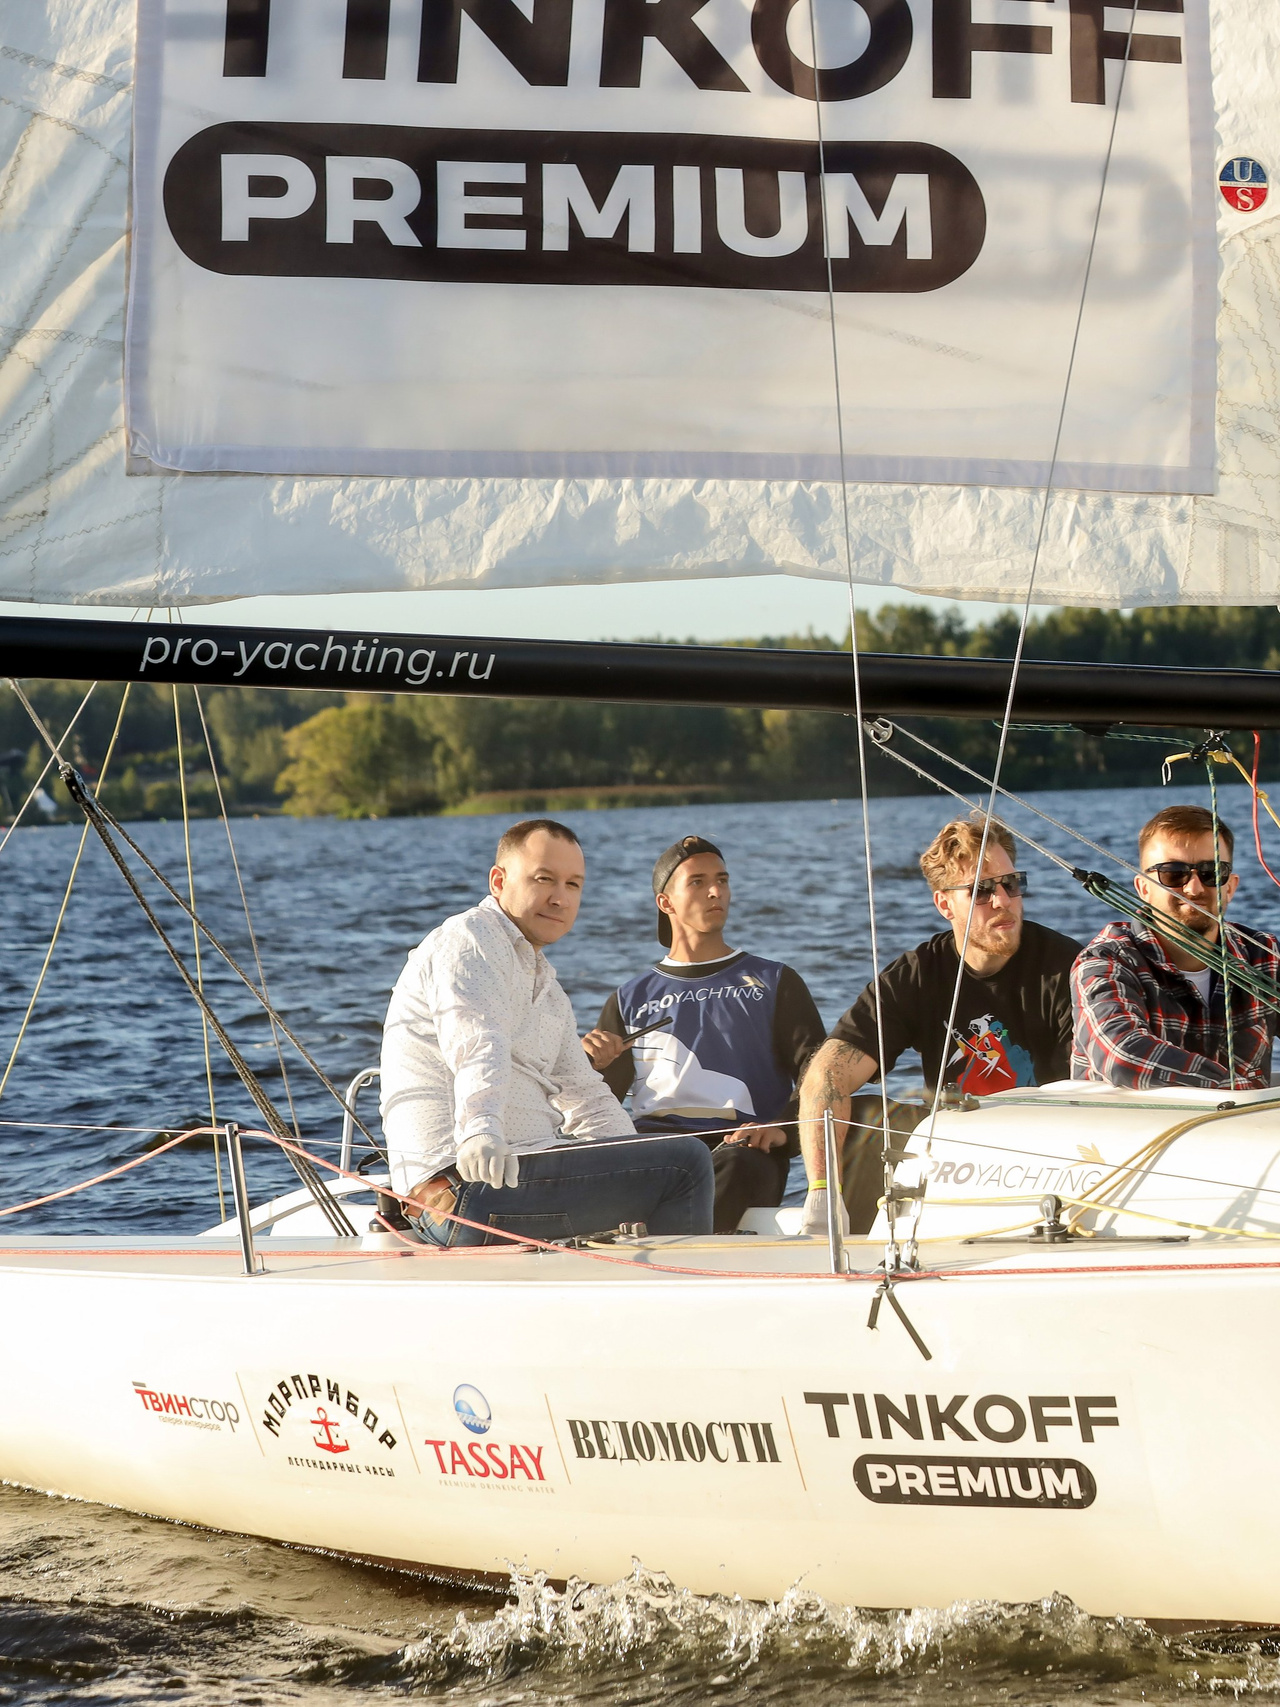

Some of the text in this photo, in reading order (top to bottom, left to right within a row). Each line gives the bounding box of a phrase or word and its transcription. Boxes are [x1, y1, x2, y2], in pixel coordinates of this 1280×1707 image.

[220, 153, 933, 260] PREMIUM
[139, 635, 496, 685] pro-yachting.ru
[636, 985, 764, 1019] PROYACHTING
[263, 1374, 397, 1450] МОРПРИБОР
[803, 1391, 1120, 1443] TINKOFF
[424, 1439, 546, 1481] TASSAY
[566, 1418, 782, 1467] ВЕДОМОСТИ
[288, 1456, 396, 1477] ЛЕГЕНДАРНЫЕ ЧАСЫ
[438, 1479, 556, 1495] PREMIUM DRINKING WATER
[865, 1462, 1083, 1500] PREMIUM
